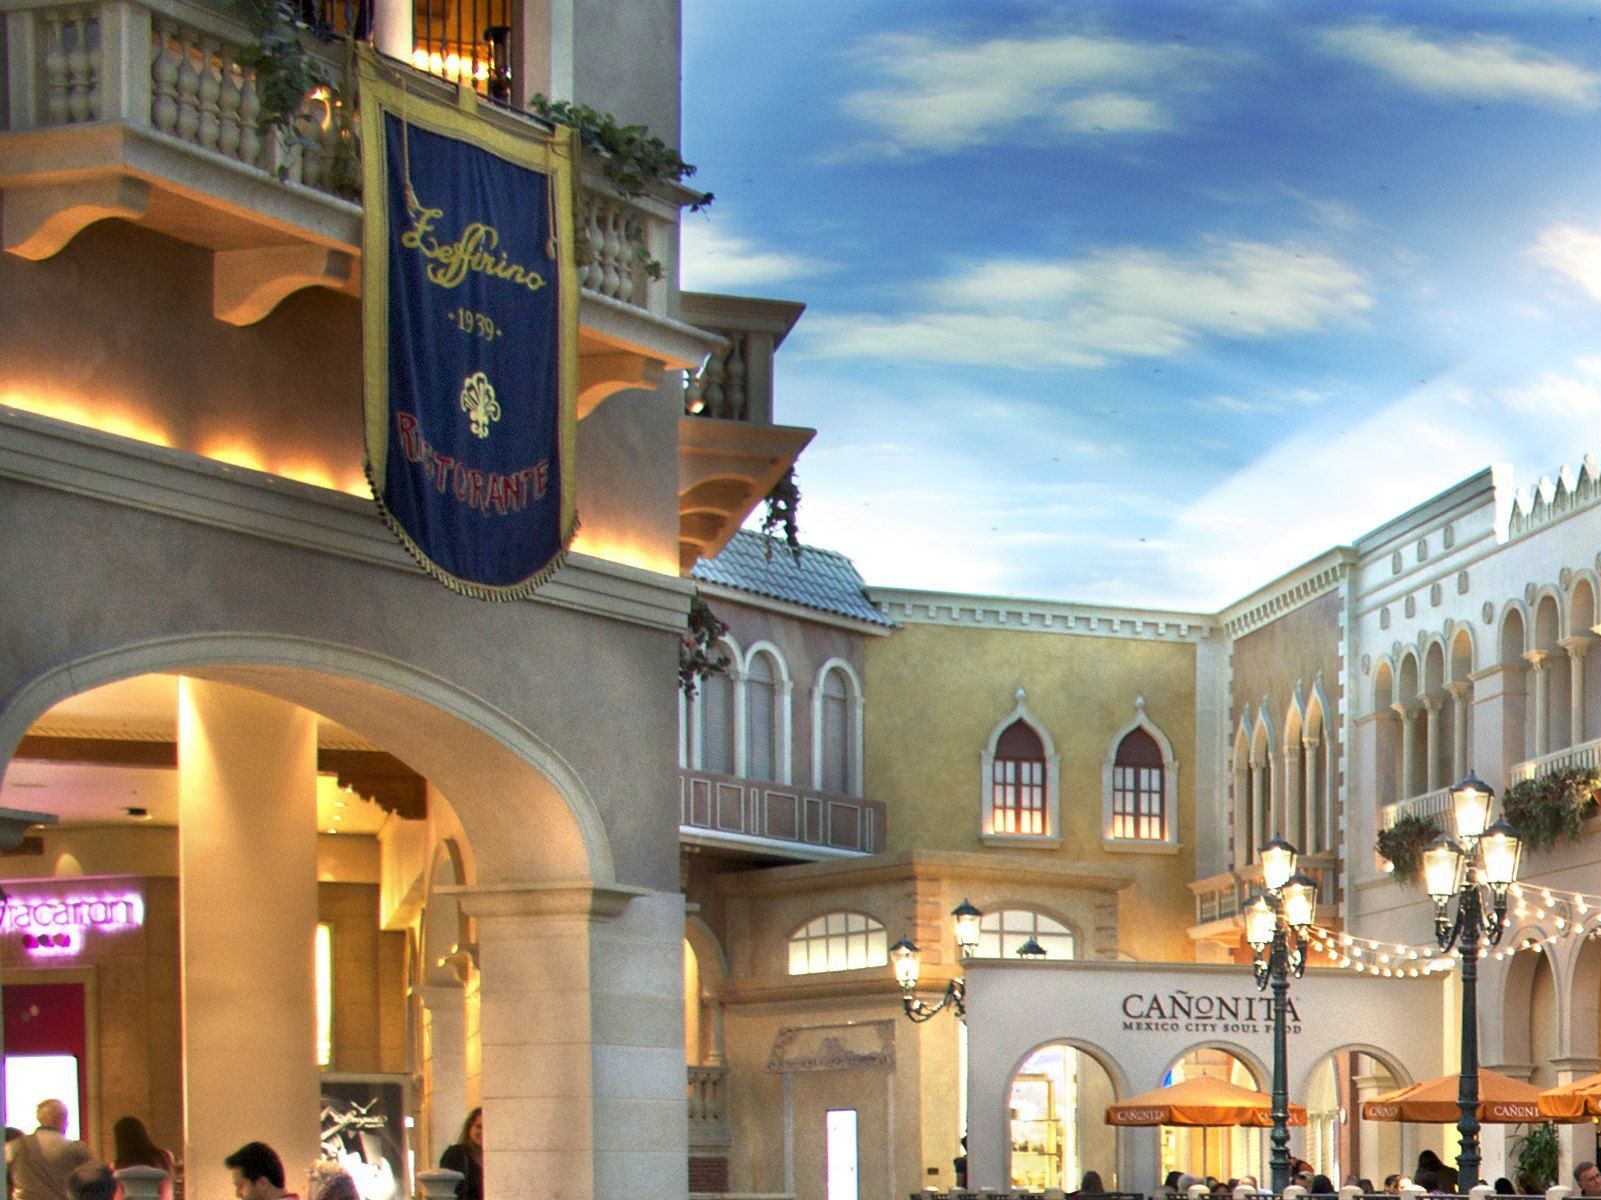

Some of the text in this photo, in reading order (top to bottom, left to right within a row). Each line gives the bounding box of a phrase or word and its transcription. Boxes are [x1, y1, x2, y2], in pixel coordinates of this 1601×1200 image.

[1122, 989, 1301, 1022] CAÑONITA
[1123, 1021, 1301, 1034] MEXICO CITY SOUL FOD
[1494, 1104, 1540, 1117] CAÑONI
